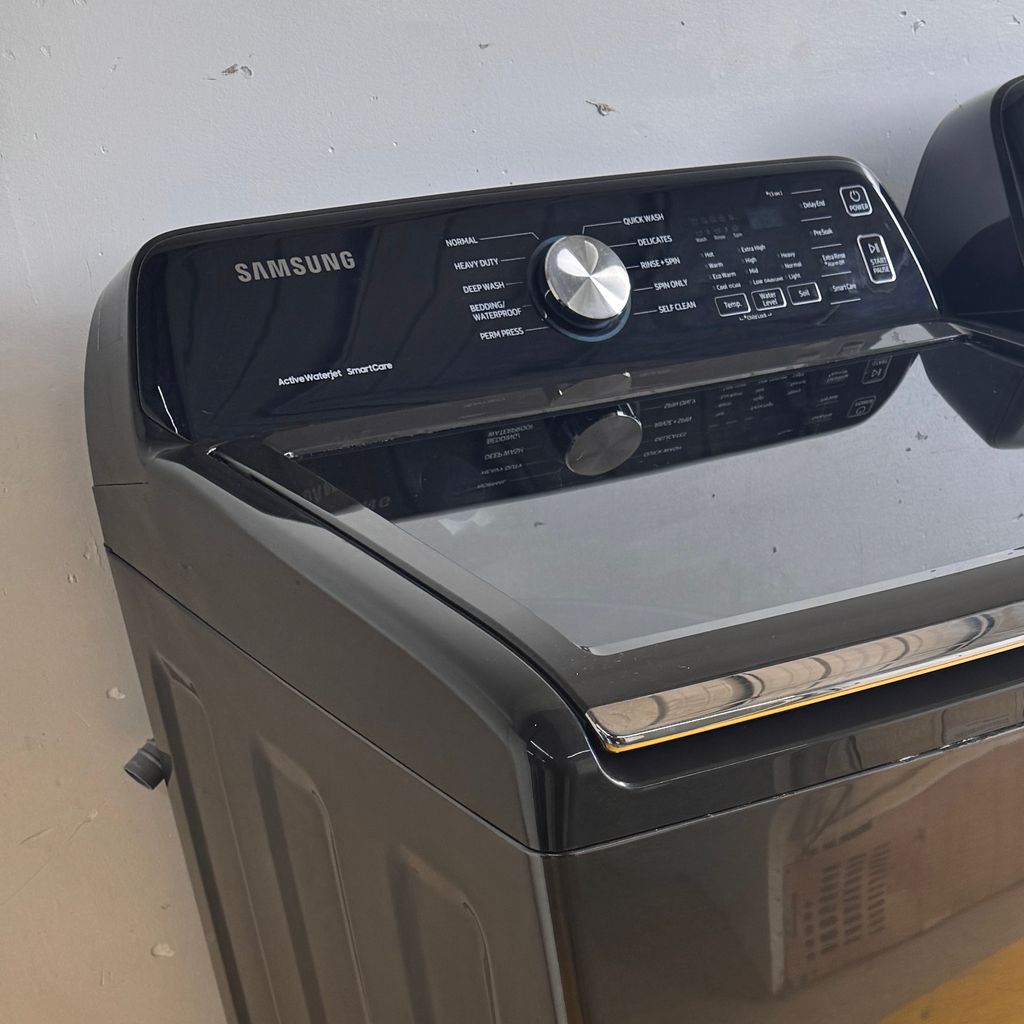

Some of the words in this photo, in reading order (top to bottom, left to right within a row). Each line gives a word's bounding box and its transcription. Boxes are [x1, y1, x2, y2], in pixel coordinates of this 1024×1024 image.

[802, 200, 816, 209] Delay
[849, 203, 868, 212] POWER
[623, 215, 644, 226] QUICK
[644, 212, 664, 223] WASH
[446, 236, 478, 247] NORMAL
[637, 234, 672, 247] DELICATES
[234, 251, 356, 282] SAMSUNG
[454, 259, 479, 270] HEAVY
[481, 257, 499, 267] DUTY
[640, 259, 660, 269] RINSE
[665, 256, 680, 266] SPIN
[870, 257, 887, 265] START
[873, 266, 890, 274] PAUSE
[463, 284, 482, 294] DEEP
[485, 282, 505, 292] WASH
[654, 281, 670, 291] SPIN
[670, 278, 688, 288] ONLY
[799, 289, 810, 298] Soil
[470, 300, 505, 313] BEDDING/
[658, 305, 674, 314] SELF
[674, 301, 697, 311] CLEAN
[724, 301, 742, 309] Temp.
[762, 299, 778, 307] Level
[473, 308, 521, 322] WATERPROOF
[480, 330, 499, 341] PERM
[500, 327, 524, 338] PRESS
[347, 362, 393, 376] SmartCare
